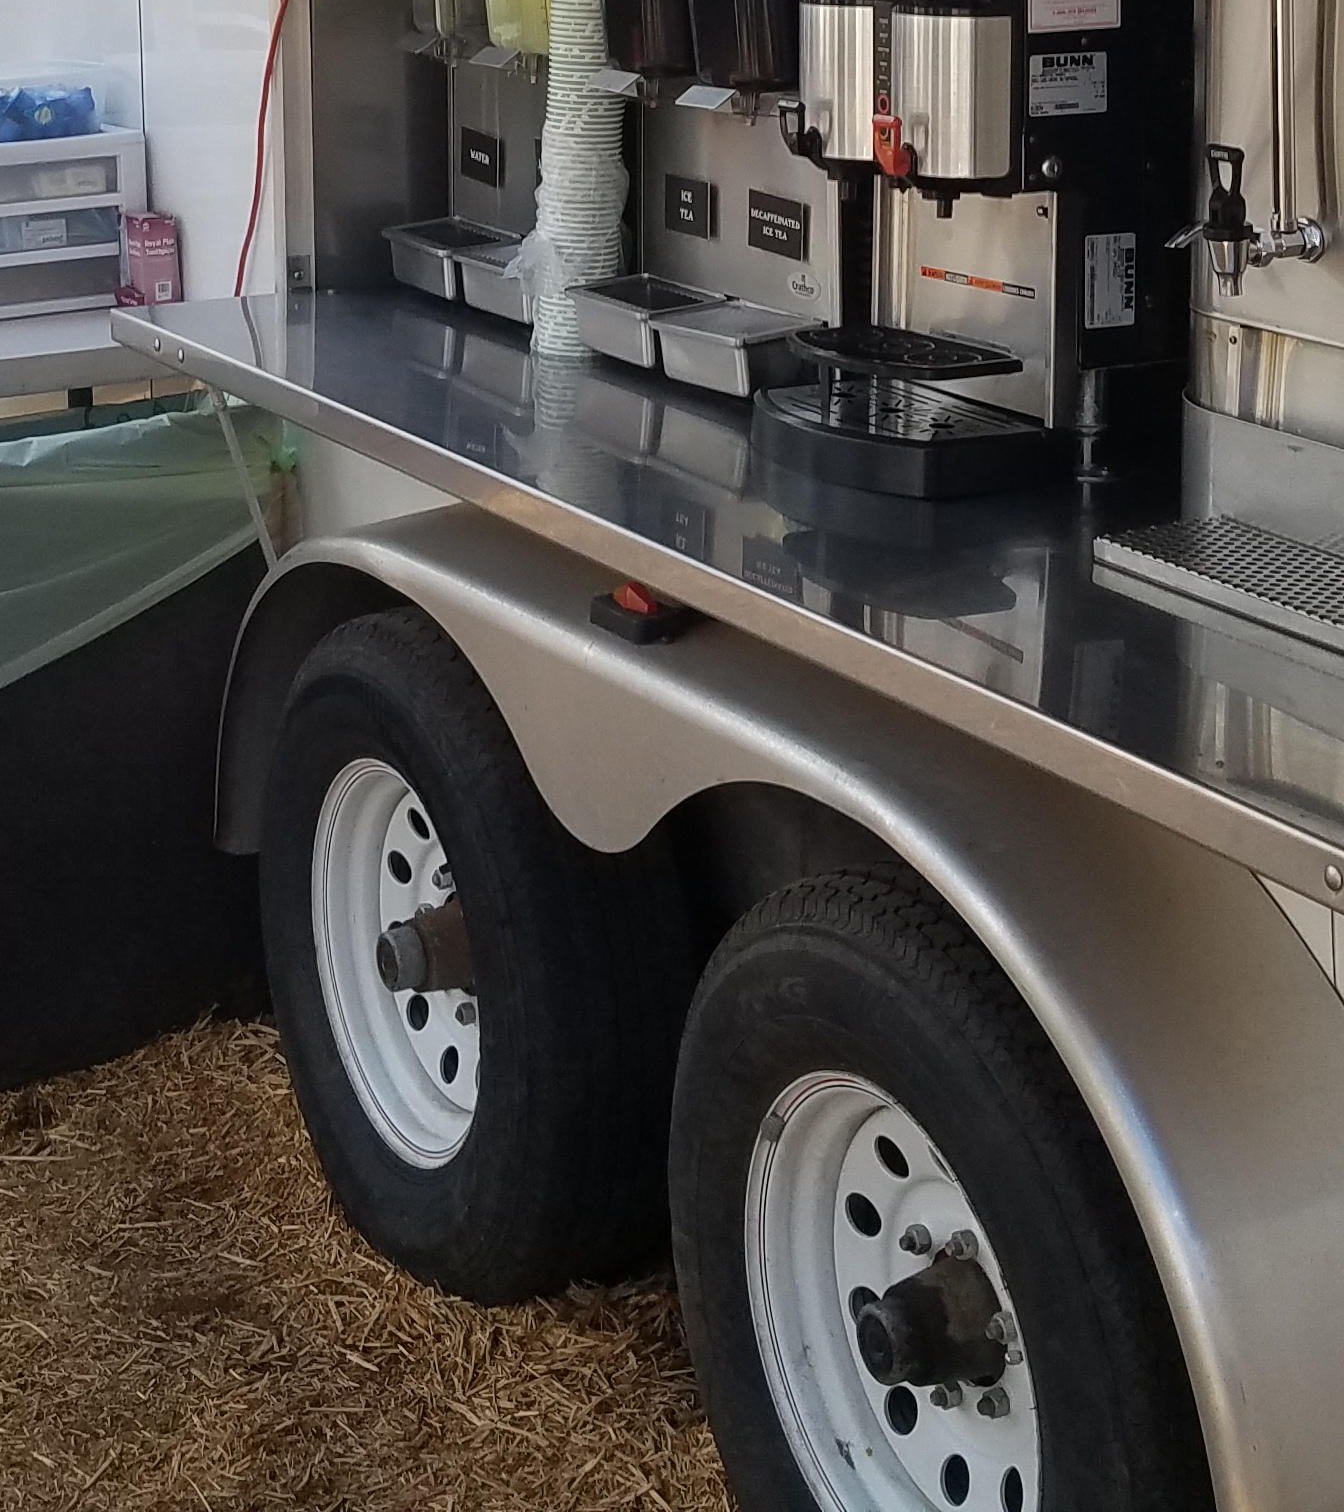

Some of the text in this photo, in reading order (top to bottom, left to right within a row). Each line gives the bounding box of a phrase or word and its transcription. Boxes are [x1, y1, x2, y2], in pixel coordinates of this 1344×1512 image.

[1042, 55, 1094, 68] BUNN
[681, 189, 693, 203] ICE
[679, 208, 694, 222] TEA
[750, 208, 801, 230] DECAFFEINATED
[762, 226, 788, 241] ICE TEA
[1124, 248, 1135, 312] BUNN
